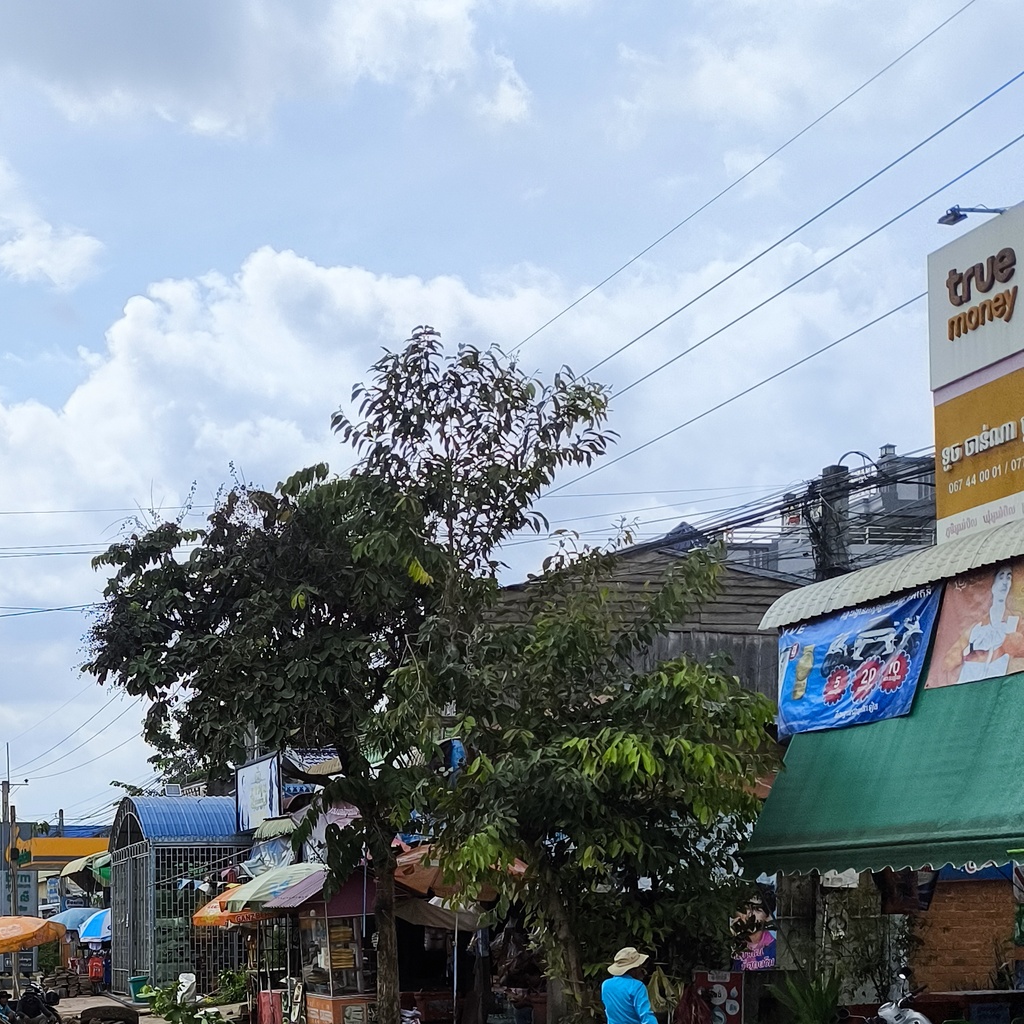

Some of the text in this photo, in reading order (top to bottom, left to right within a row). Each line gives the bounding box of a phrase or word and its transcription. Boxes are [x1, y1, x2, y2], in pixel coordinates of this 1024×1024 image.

[946, 247, 1017, 307] true
[947, 285, 1018, 342] money
[948, 478, 963, 494] 067
[965, 473, 976, 487] 44
[979, 468, 990, 483] 00
[992, 463, 1002, 478] 01
[860, 667, 877, 685] 20
[888, 661, 900, 675] 10
[833, 676, 842, 689] 5
